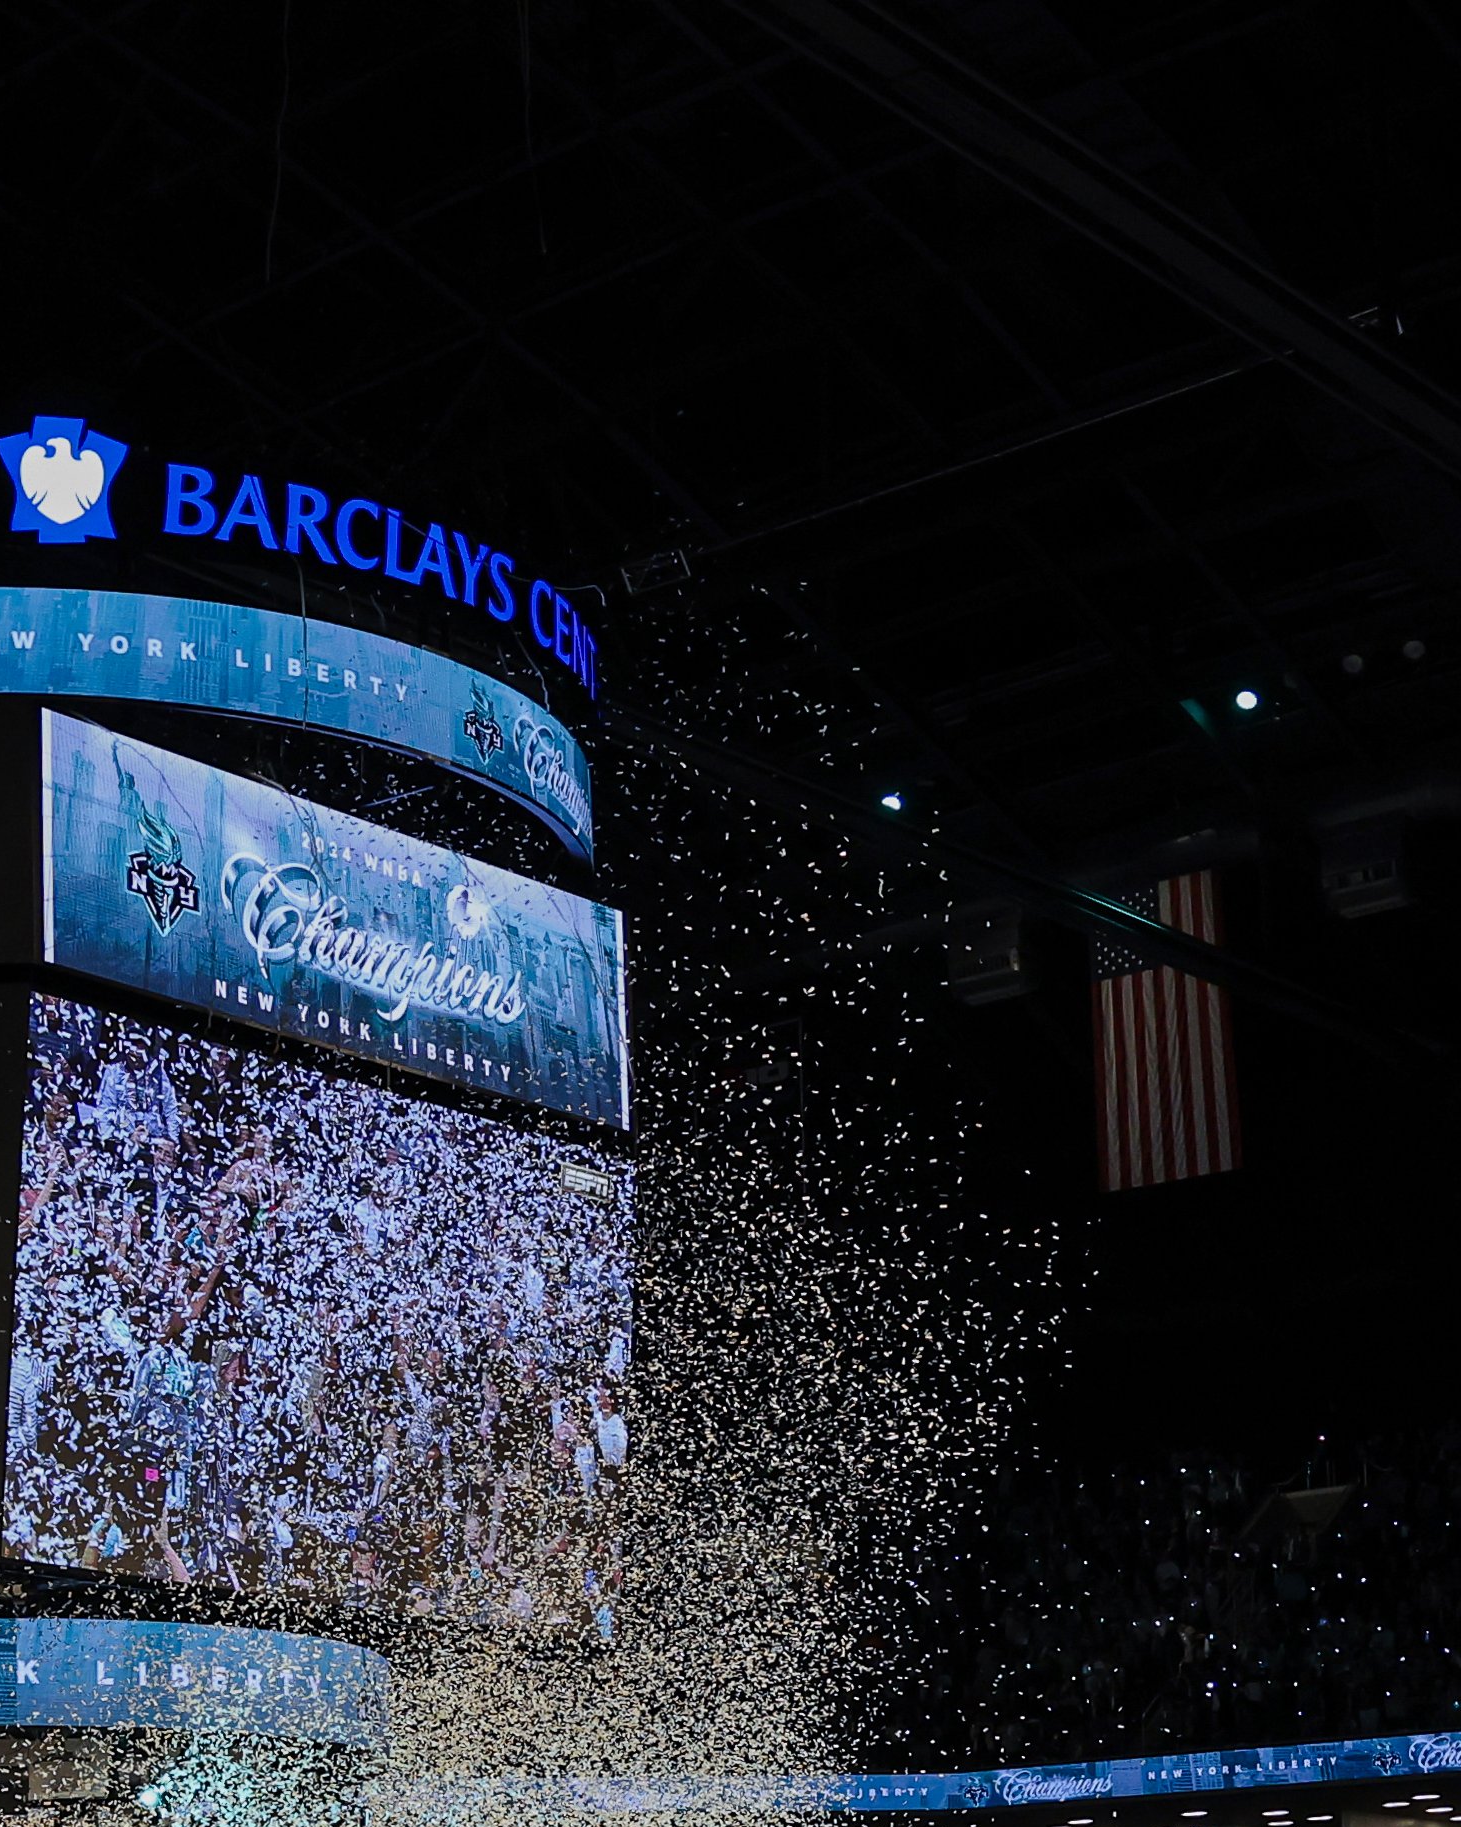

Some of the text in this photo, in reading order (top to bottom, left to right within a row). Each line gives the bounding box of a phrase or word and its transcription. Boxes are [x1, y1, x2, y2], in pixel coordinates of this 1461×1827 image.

[163, 463, 516, 622] BARCLAYS
[77, 633, 198, 662] YORK
[236, 647, 409, 702] LIBERTY
[300, 831, 424, 888] 2024 WNBA
[221, 851, 526, 1023] Champions
[215, 978, 513, 1082] NEW YORK LIBERTY
[565, 1169, 611, 1197] ESPN
[96, 1660, 324, 1697] LIBERTY
[994, 1767, 1113, 1802] Champions
[1147, 1769, 1184, 1782] NEW
[1196, 1763, 1244, 1777] YORK
[1256, 1756, 1339, 1773] LIBERTY
